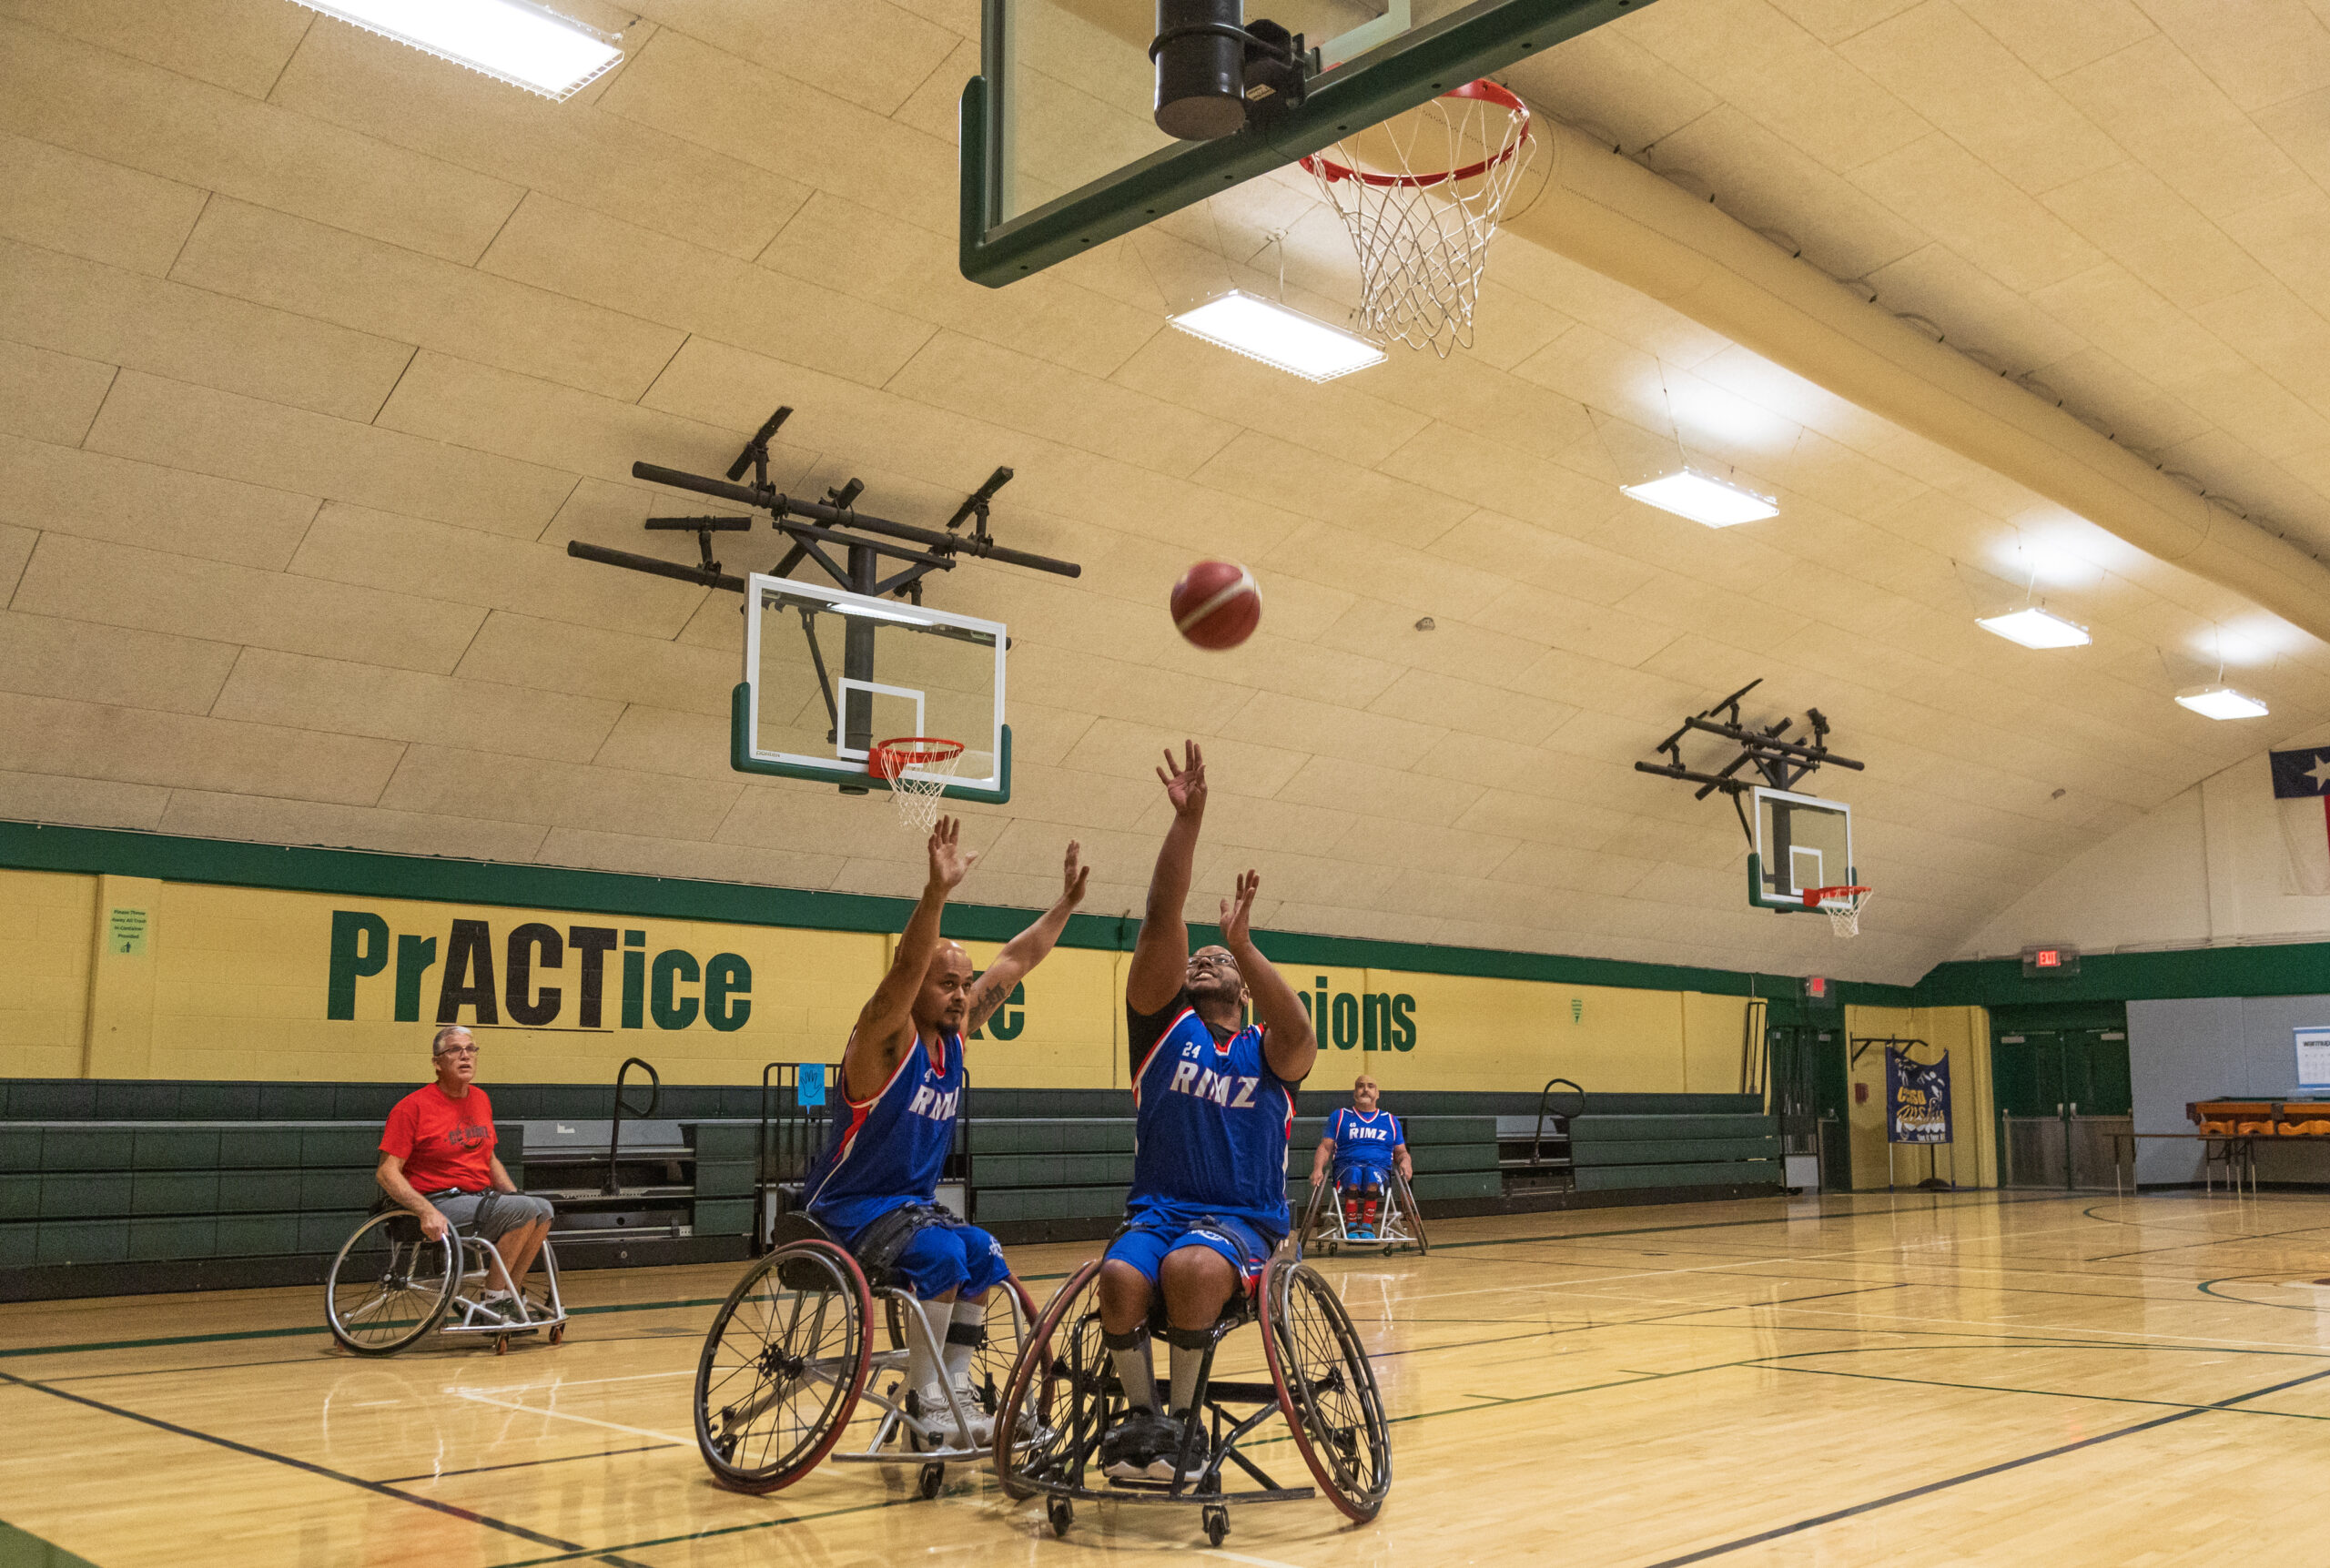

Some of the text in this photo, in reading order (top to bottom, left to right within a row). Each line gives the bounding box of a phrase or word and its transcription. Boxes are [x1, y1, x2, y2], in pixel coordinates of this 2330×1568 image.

[2039, 951, 2057, 966] EXIT
[327, 910, 752, 1032] PrACTice
[1182, 1041, 1201, 1059] 24
[1170, 1060, 1260, 1108] RIMZ
[1349, 1128, 1388, 1141] RIMZ
